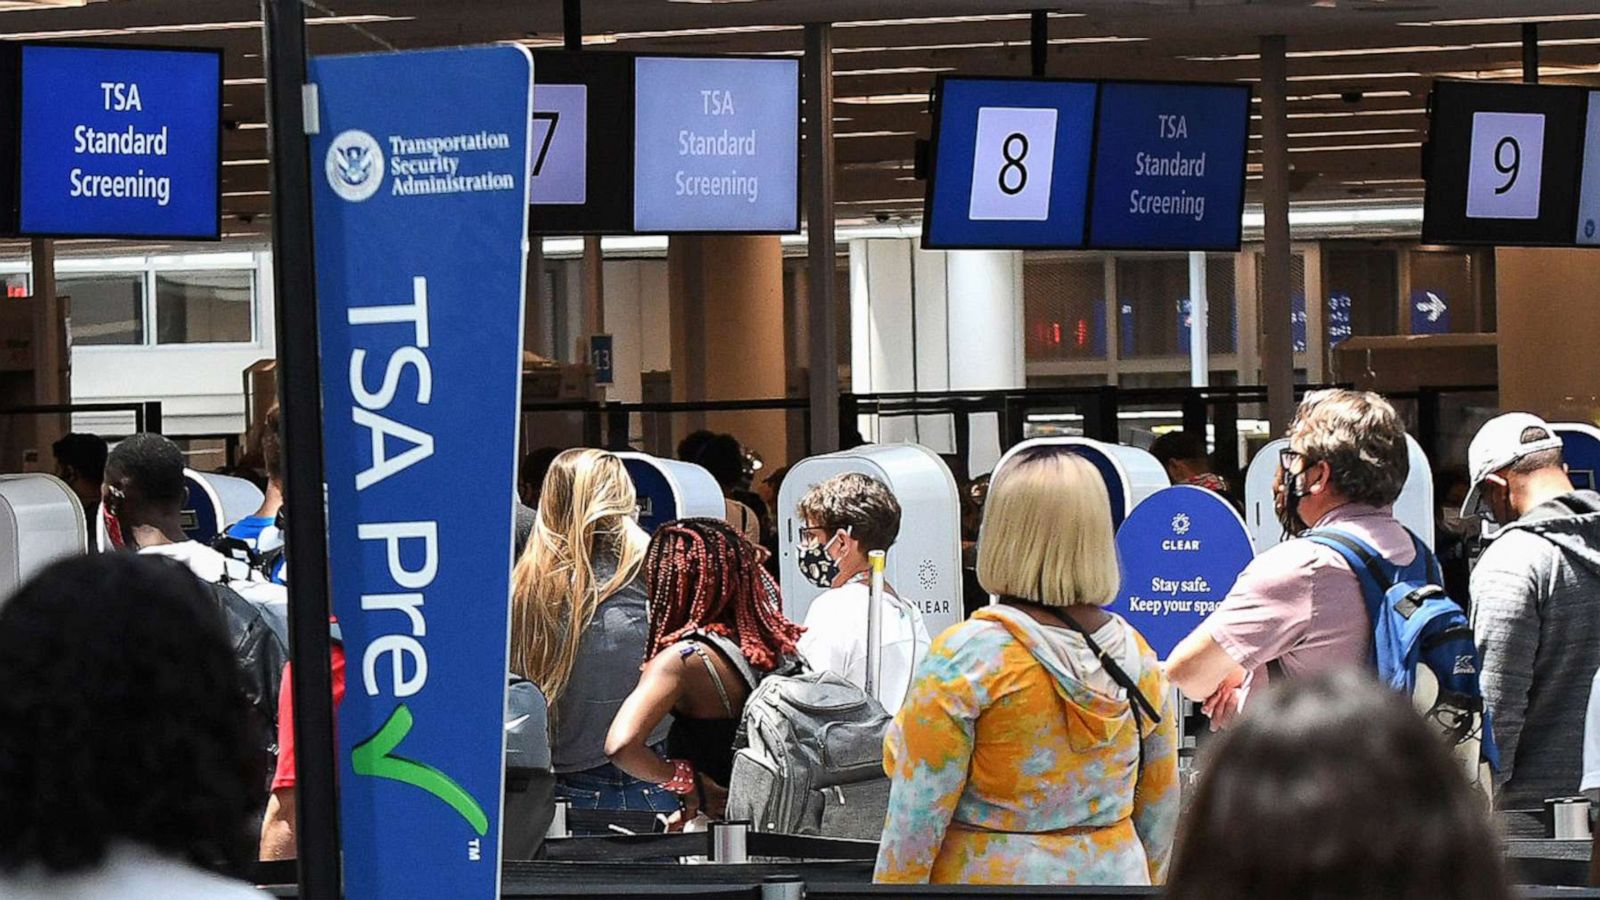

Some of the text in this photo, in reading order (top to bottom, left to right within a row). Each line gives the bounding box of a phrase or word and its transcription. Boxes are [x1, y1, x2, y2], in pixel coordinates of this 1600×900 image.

[101, 82, 142, 111] TSA
[701, 90, 735, 115] TSA
[74, 124, 167, 155] Standard
[1158, 115, 1188, 139] TSA
[389, 131, 510, 157] Transportation
[532, 111, 559, 176] 7
[679, 129, 756, 156] Standard
[391, 155, 459, 177] Security
[998, 132, 1029, 195] 8
[1135, 151, 1206, 177] Standard
[1494, 136, 1521, 195] 9
[70, 168, 170, 206] Screening
[392, 171, 514, 196] Administration
[675, 170, 758, 203] Screening
[1129, 189, 1205, 221] Screening
[593, 350, 609, 370] 13
[347, 276, 439, 697] TSA Pre
[1162, 540, 1200, 550] CLEAR
[1152, 576, 1211, 596] Stay safe.
[912, 600, 950, 614] LEAR
[1130, 597, 1162, 615] Keep
[1163, 600, 1192, 616] your
